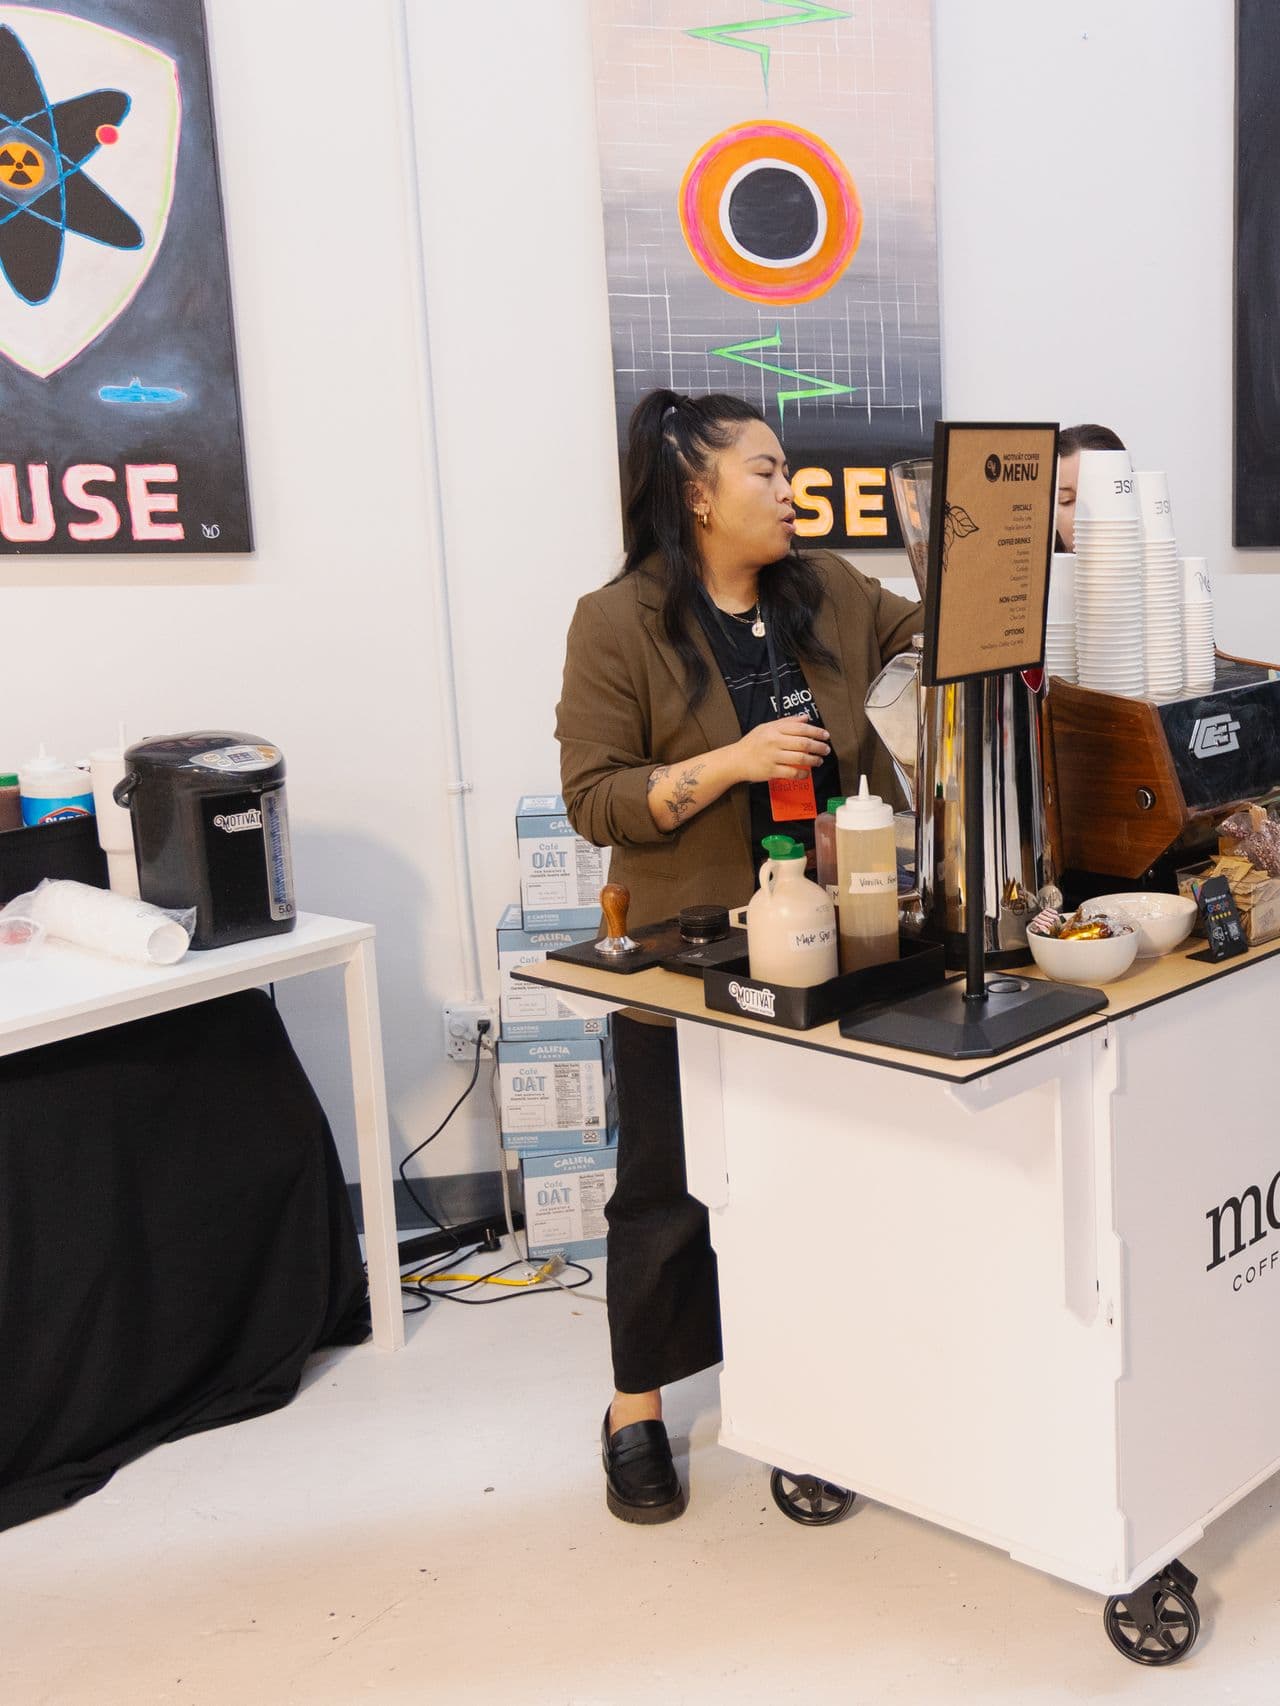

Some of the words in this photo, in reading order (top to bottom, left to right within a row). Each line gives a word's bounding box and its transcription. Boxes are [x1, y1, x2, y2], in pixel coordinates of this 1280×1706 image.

[1002, 463, 1038, 482] MENU
[1004, 627, 1025, 636] OPTIONS
[532, 851, 568, 869] OAT
[278, 904, 292, 914] 5.0
[1207, 900, 1230, 913] Google
[529, 1045, 570, 1055] CALIFIA
[512, 1076, 546, 1093] OAT
[553, 1156, 596, 1168] CALIFIA
[537, 1188, 572, 1206] OAT
